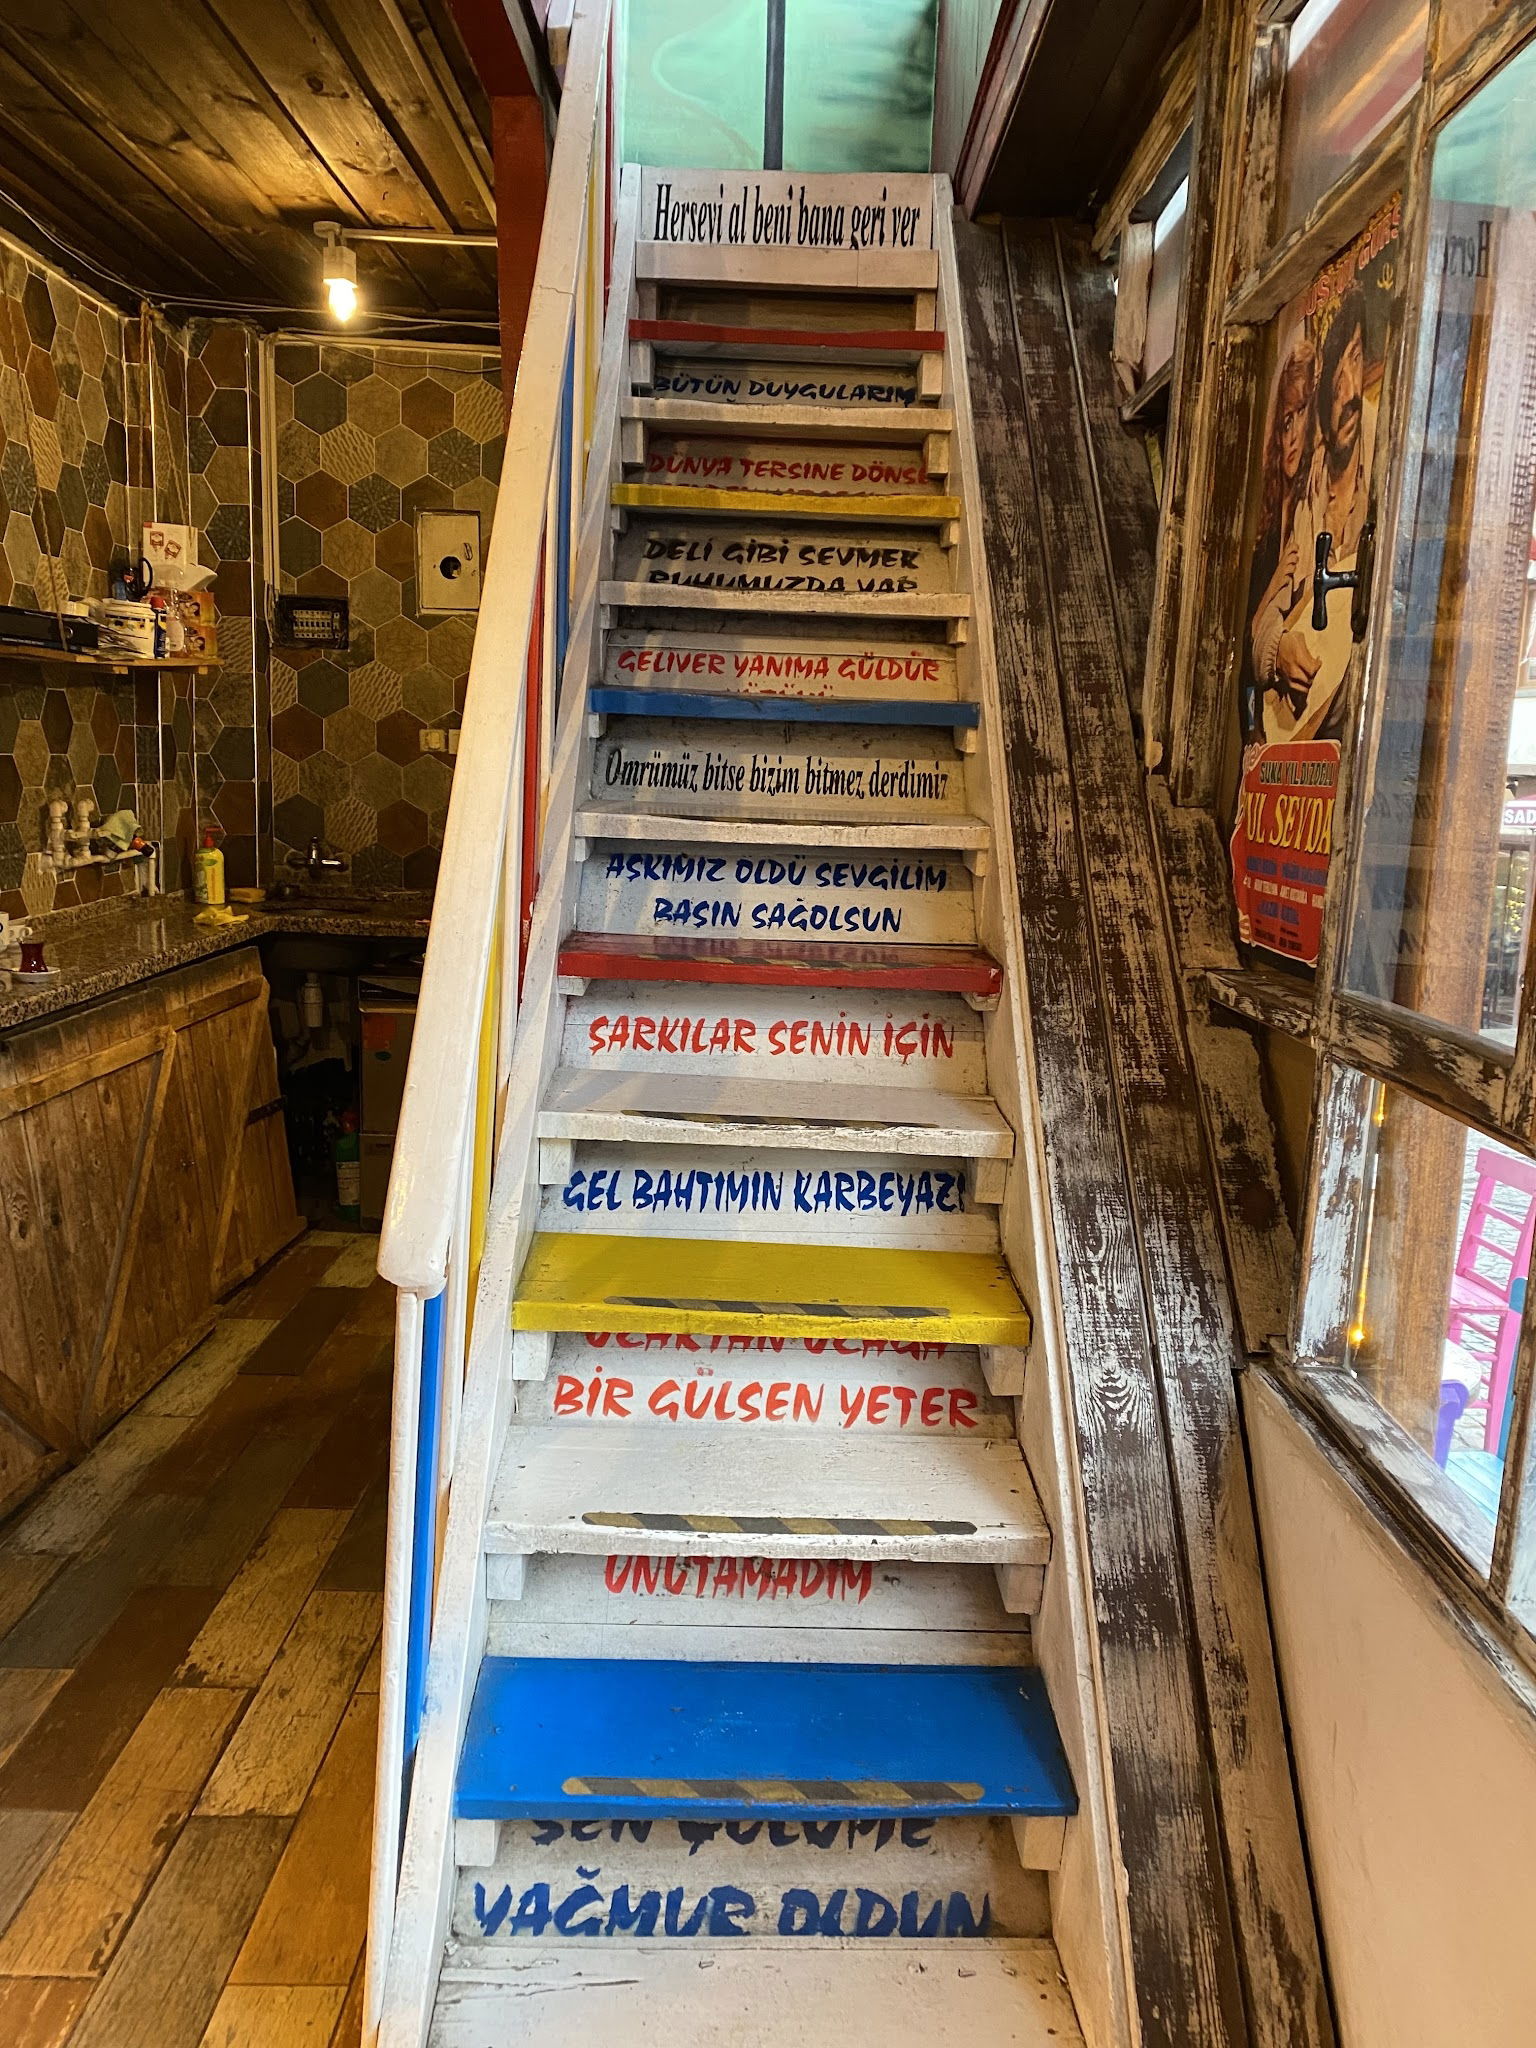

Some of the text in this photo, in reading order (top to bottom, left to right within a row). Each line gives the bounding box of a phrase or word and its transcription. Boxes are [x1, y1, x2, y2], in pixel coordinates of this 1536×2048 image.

[728, 186, 748, 244] al
[752, 184, 793, 244] beni
[797, 185, 845, 246] bana
[849, 186, 887, 250] geri
[892, 205, 920, 247] ver
[654, 373, 741, 395] BÜTÜN
[798, 545, 920, 569] SEVMEK
[734, 654, 829, 680] YANIMA
[837, 651, 940, 682] GÜLDÜR
[702, 752, 745, 792] bitse
[750, 754, 800, 797] bizim
[804, 755, 865, 800] bitmez
[815, 858, 947, 893] SEVGİLİM
[768, 1011, 872, 1056] SENİN
[883, 1012, 954, 1064] İÇİN
[562, 1169, 622, 1212] GEL
[632, 1169, 784, 1213] BAHTIMIN
[554, 1365, 634, 1418] BİR
[841, 1384, 979, 1429] YETER
[474, 1865, 990, 1938] YAĞMUR OLDUN
